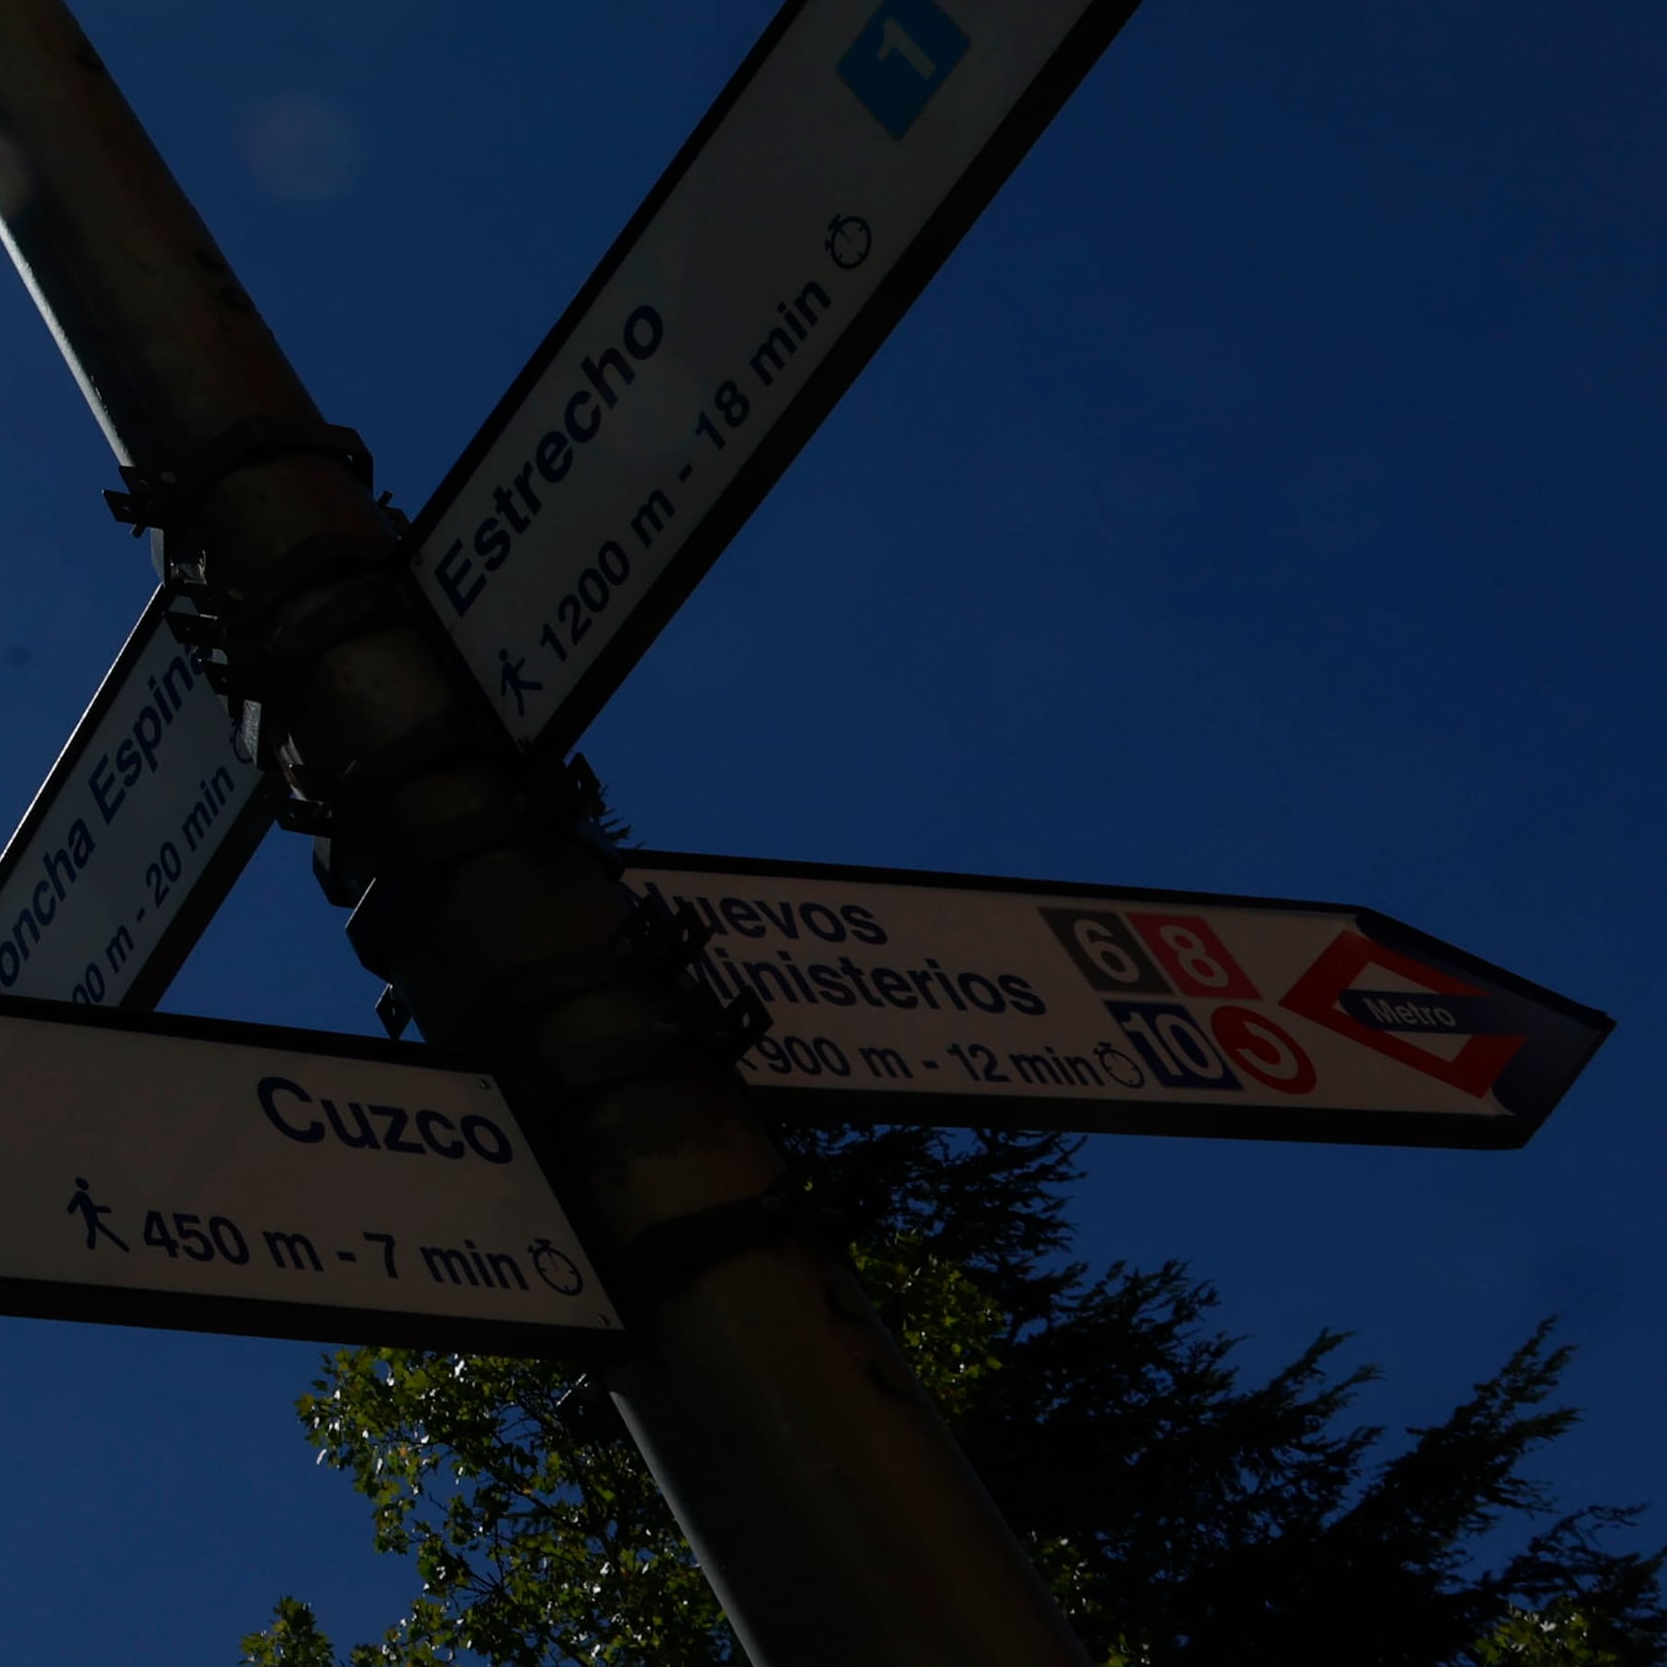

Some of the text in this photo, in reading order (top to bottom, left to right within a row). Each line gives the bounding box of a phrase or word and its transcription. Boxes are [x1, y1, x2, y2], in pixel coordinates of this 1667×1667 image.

[875, 15, 938, 82] 1
[433, 304, 665, 617] Estrecho
[540, 540, 631, 662] 1200
[630, 488, 676, 548] m
[695, 380, 750, 450] 18
[749, 280, 833, 386] min
[105, 925, 135, 974] m
[146, 840, 182, 908] 20
[181, 765, 236, 852] min
[1072, 917, 1230, 990] 6 8
[1121, 1010, 1226, 1081] 10
[1362, 997, 1458, 1028] Metro
[756, 1034, 851, 1077] 900
[859, 1045, 913, 1080] m
[946, 1042, 1011, 1082] 12
[1008, 1045, 1105, 1087] min
[256, 1076, 513, 1164] Cuzco
[143, 1210, 250, 1266] 450
[262, 1231, 324, 1272] m
[363, 1231, 399, 1279] 7
[420, 1238, 530, 1291] min
